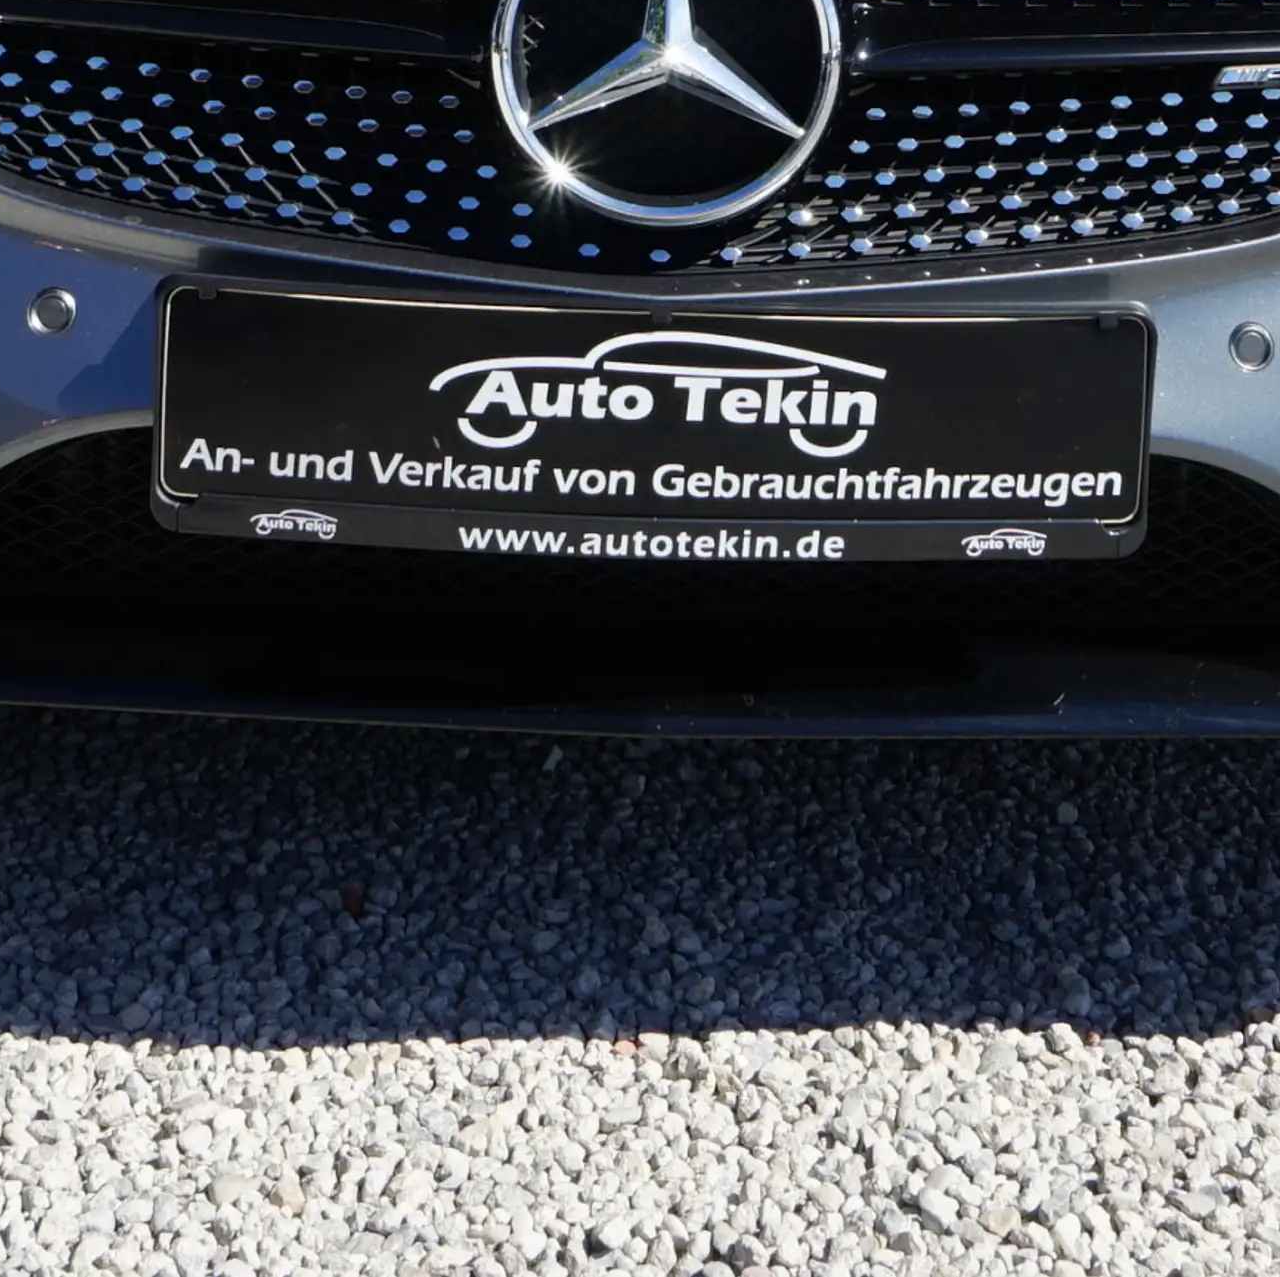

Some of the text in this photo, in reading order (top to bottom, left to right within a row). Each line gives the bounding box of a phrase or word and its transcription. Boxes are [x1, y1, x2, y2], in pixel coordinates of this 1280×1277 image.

[465, 370, 878, 427] Auto Tekin
[179, 438, 1124, 509] An- und Verkauf von Gebrauchtfahrzeugen
[258, 517, 337, 533] Auto Tekin
[458, 526, 846, 560] www.autotekin.de
[968, 536, 1046, 550] Auto Tekin
